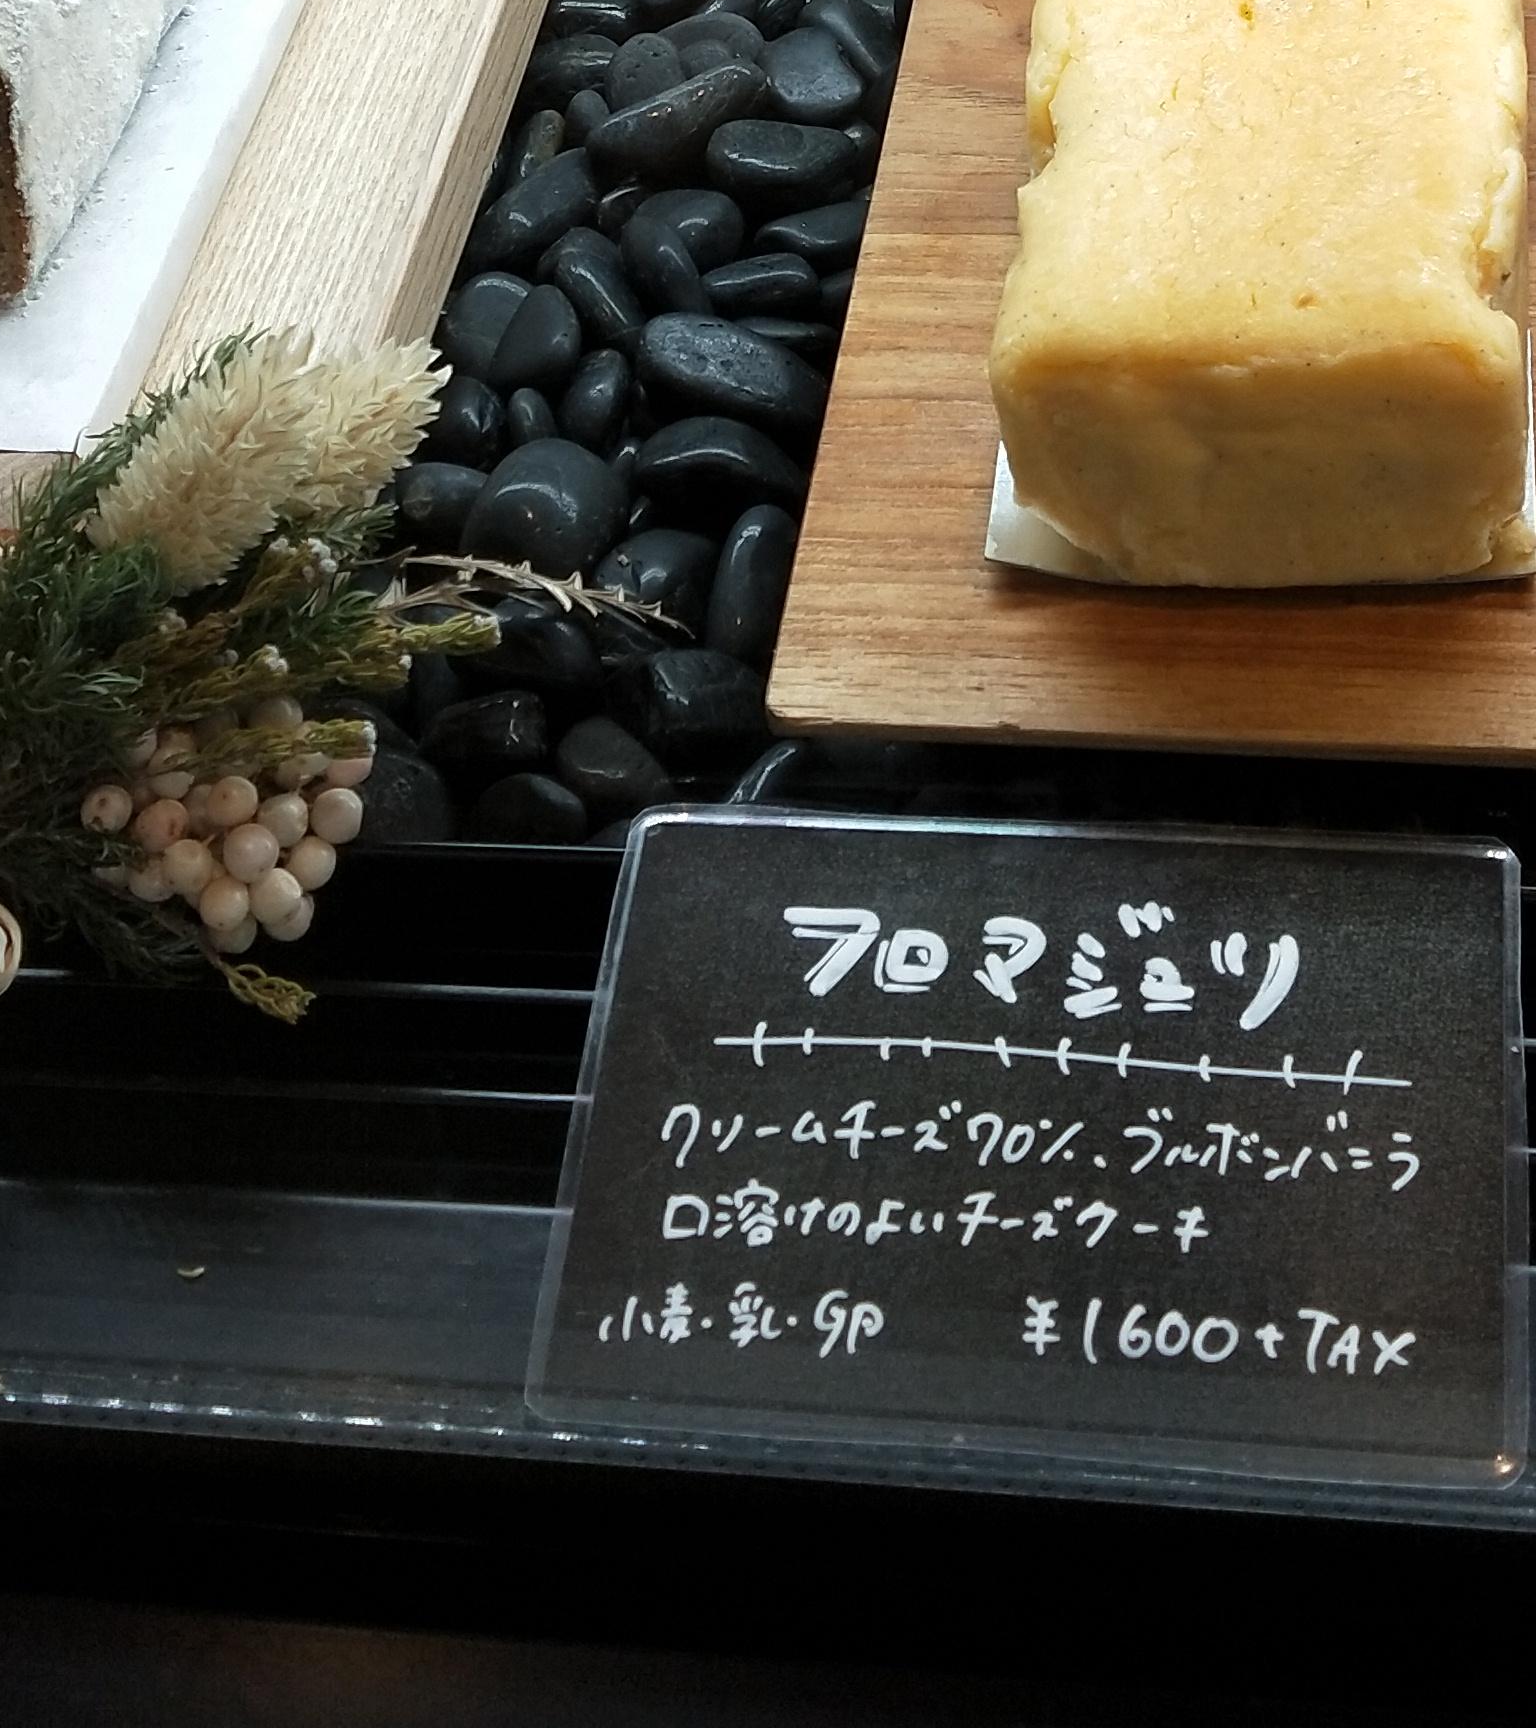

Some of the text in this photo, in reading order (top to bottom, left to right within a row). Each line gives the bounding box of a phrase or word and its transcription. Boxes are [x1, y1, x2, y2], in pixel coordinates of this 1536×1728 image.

[662, 1177, 1211, 1248] 口溶けのよいチーズケーキ
